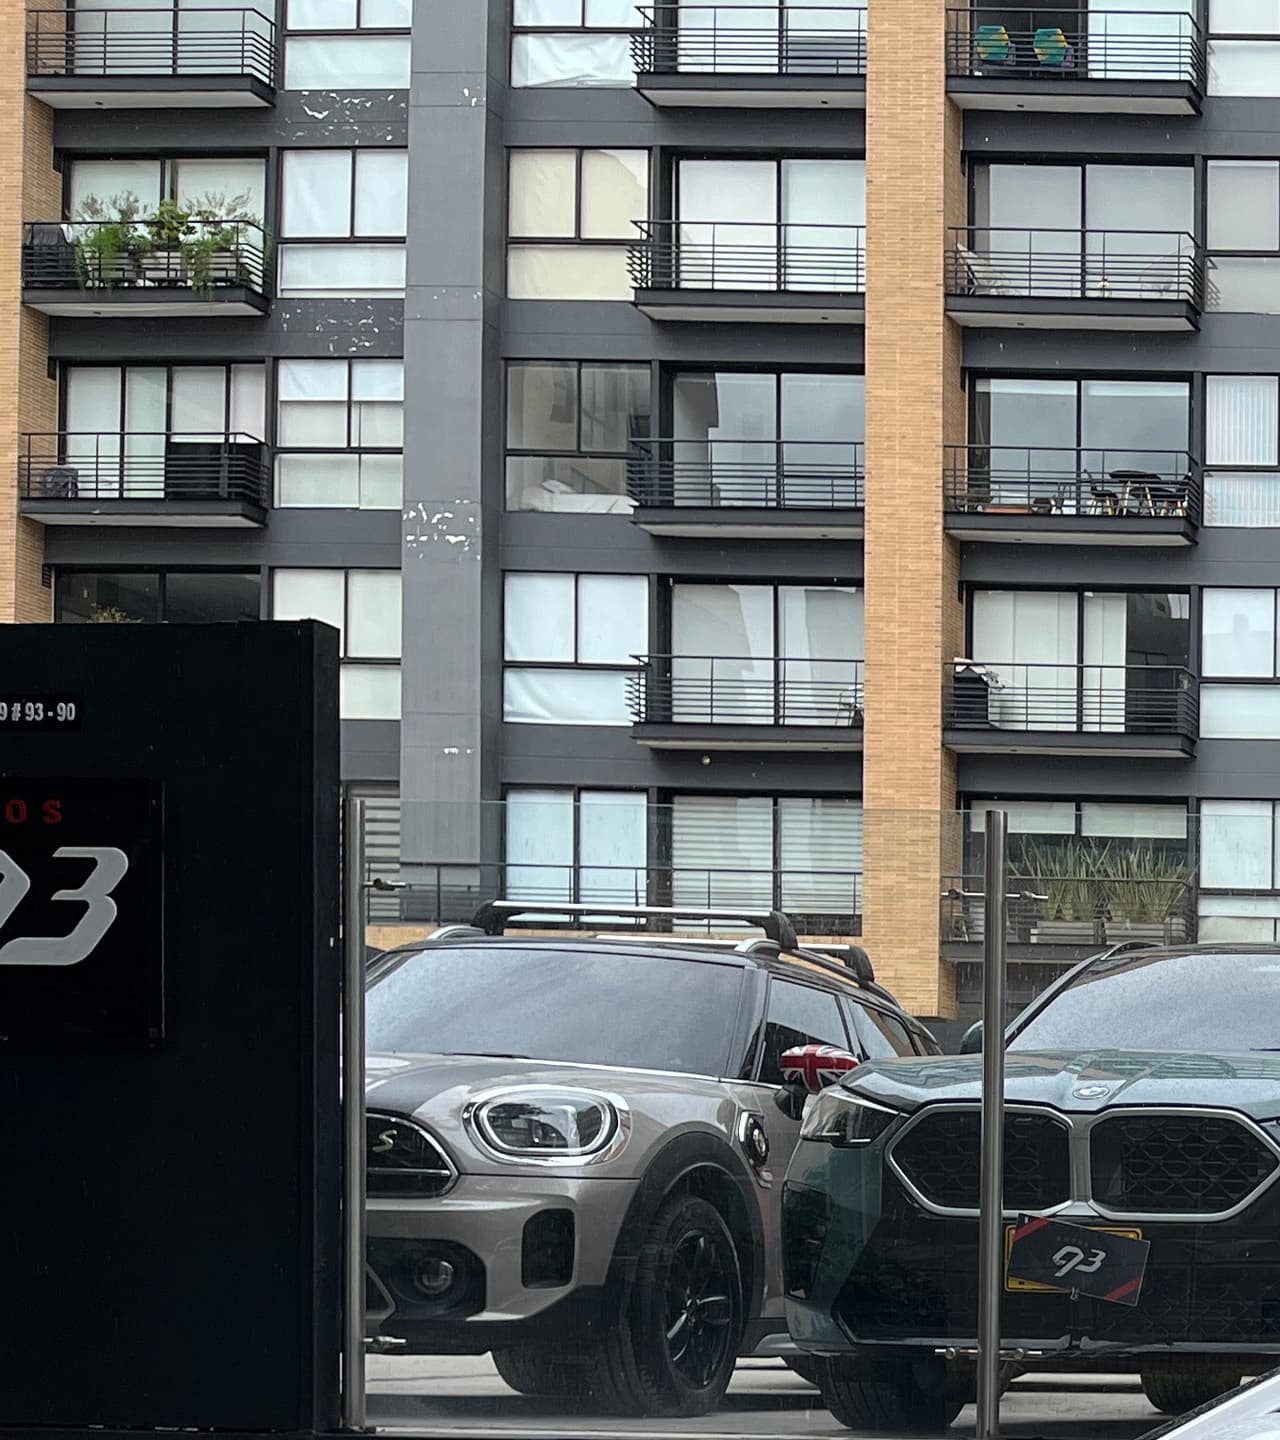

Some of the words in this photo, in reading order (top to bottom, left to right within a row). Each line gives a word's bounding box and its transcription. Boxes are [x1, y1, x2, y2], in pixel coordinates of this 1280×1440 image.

[25, 703, 44, 721] 93
[56, 703, 76, 721] 90
[0, 846, 129, 966] 3
[1052, 1245, 1106, 1277] 93
